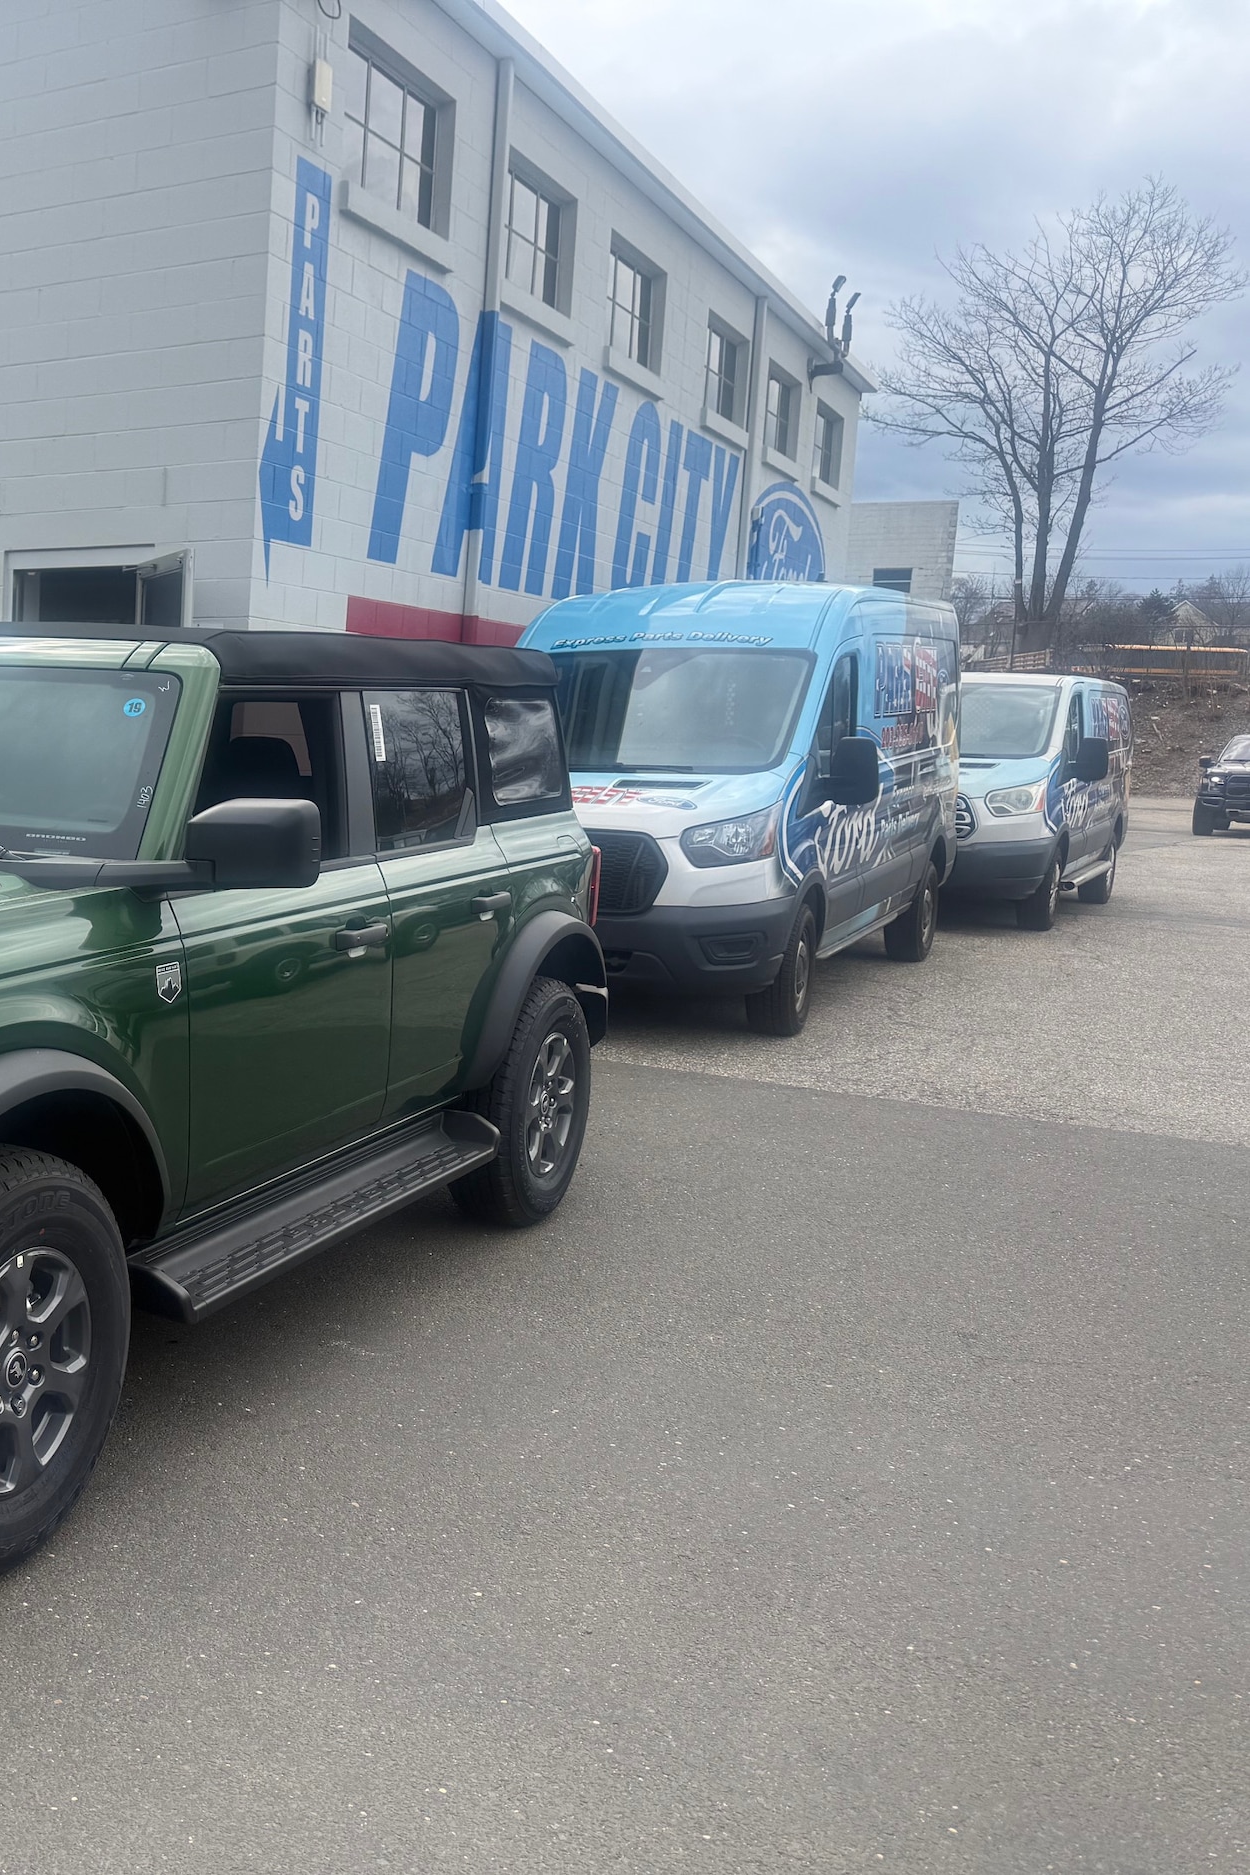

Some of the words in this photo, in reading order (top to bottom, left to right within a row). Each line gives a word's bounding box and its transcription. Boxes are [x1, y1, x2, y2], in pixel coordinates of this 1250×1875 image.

[288, 192, 319, 521] PARTS
[367, 268, 620, 599] PARK
[611, 400, 740, 592] CITY
[550, 634, 627, 650] Express
[629, 631, 684, 643] Parts
[686, 630, 774, 647] Delivery
[128, 702, 142, 713] 19
[26, 833, 86, 842] BRONCO
